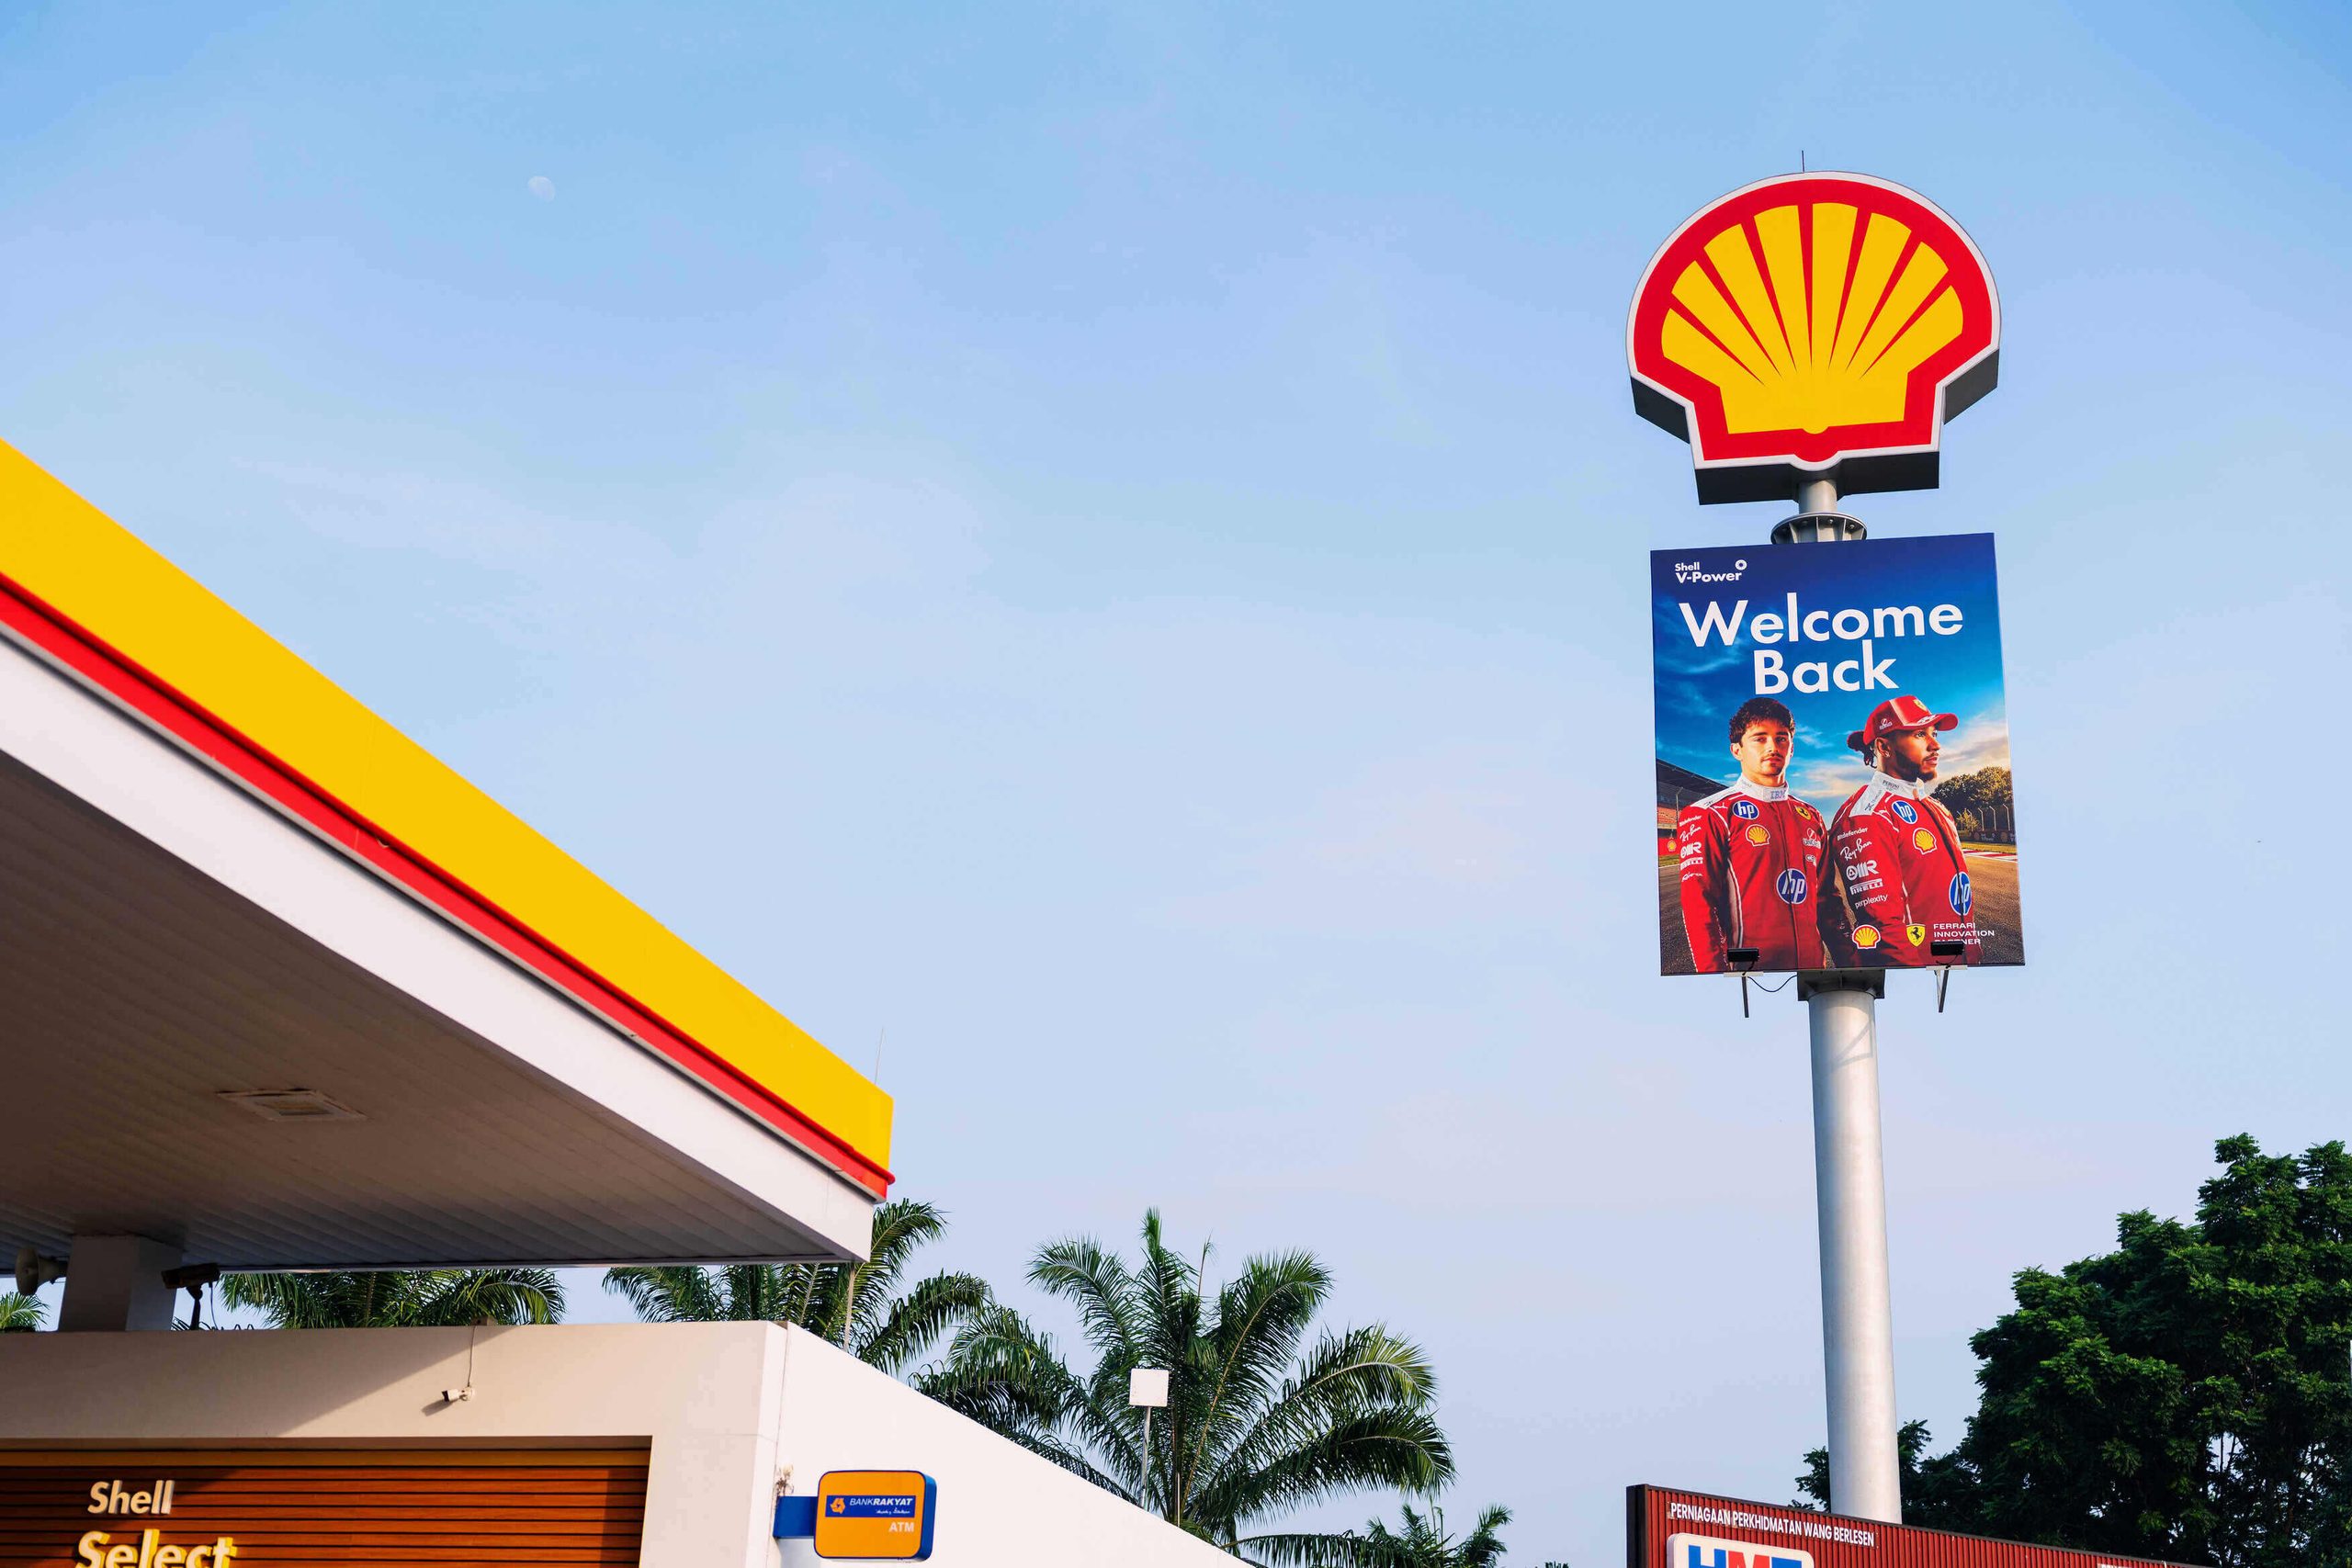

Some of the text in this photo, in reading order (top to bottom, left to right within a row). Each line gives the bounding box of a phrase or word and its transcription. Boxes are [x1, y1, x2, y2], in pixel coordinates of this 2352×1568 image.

[1675, 561, 1700, 571] Shell
[1675, 571, 1742, 583] V-Power
[1679, 592, 1963, 647] Welcome
[1754, 639, 1899, 694] Back
[1770, 789, 1787, 800] IBM
[1840, 838, 1872, 861] Ray-Ban
[1849, 878, 1883, 895] PIRELLI
[1933, 930, 1995, 938] INNOVATION
[87, 1480, 175, 1514] Shell
[888, 1521, 915, 1532] ATM
[1670, 1502, 1874, 1547] PERNIAGAAN PERKHIDMATAN WANG BERLESEN
[75, 1529, 238, 1568] Select
